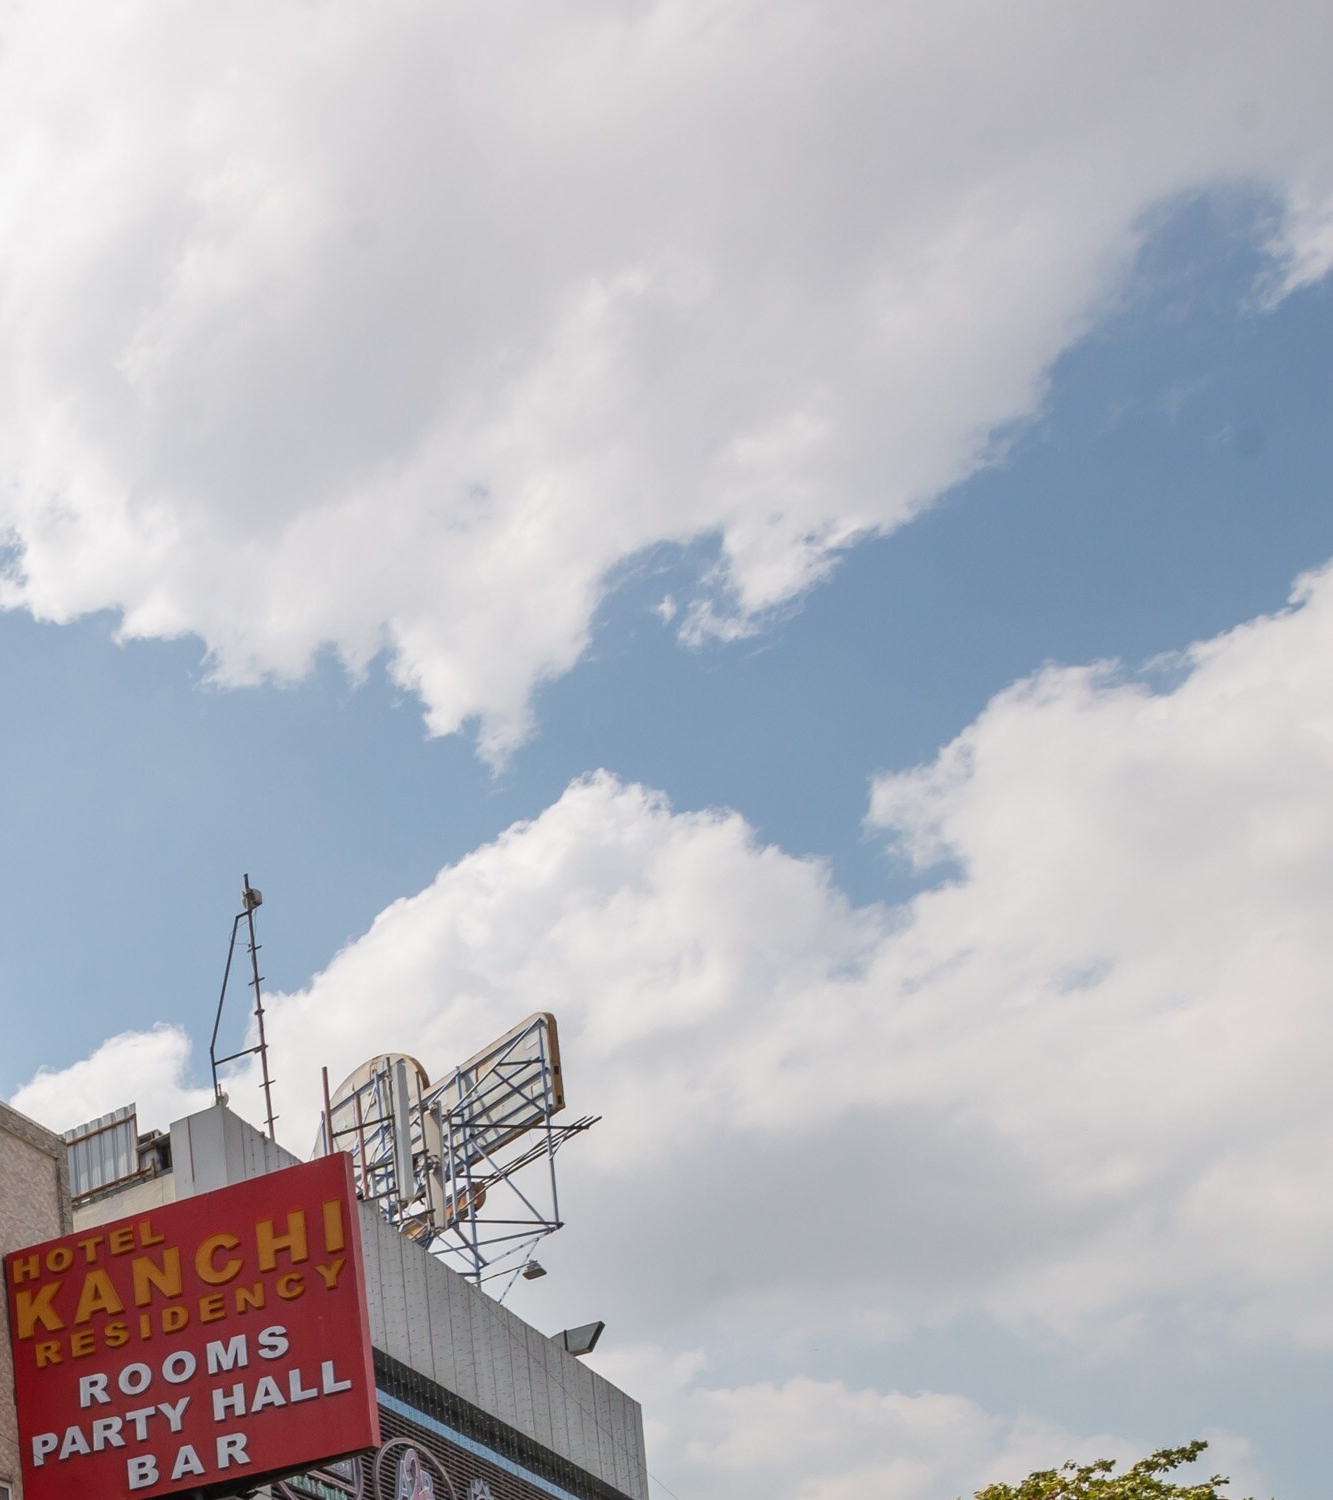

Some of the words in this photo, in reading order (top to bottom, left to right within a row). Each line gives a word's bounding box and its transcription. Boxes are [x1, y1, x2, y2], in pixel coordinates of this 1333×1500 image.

[13, 1220, 165, 1284] HOTEL
[15, 1200, 346, 1340] KANCHI
[35, 1258, 347, 1368] RESIDENCY
[31, 1397, 191, 1466] PARTY
[212, 1360, 352, 1421] HALL
[79, 1325, 290, 1407] ROOMS
[127, 1432, 251, 1490] BAR
